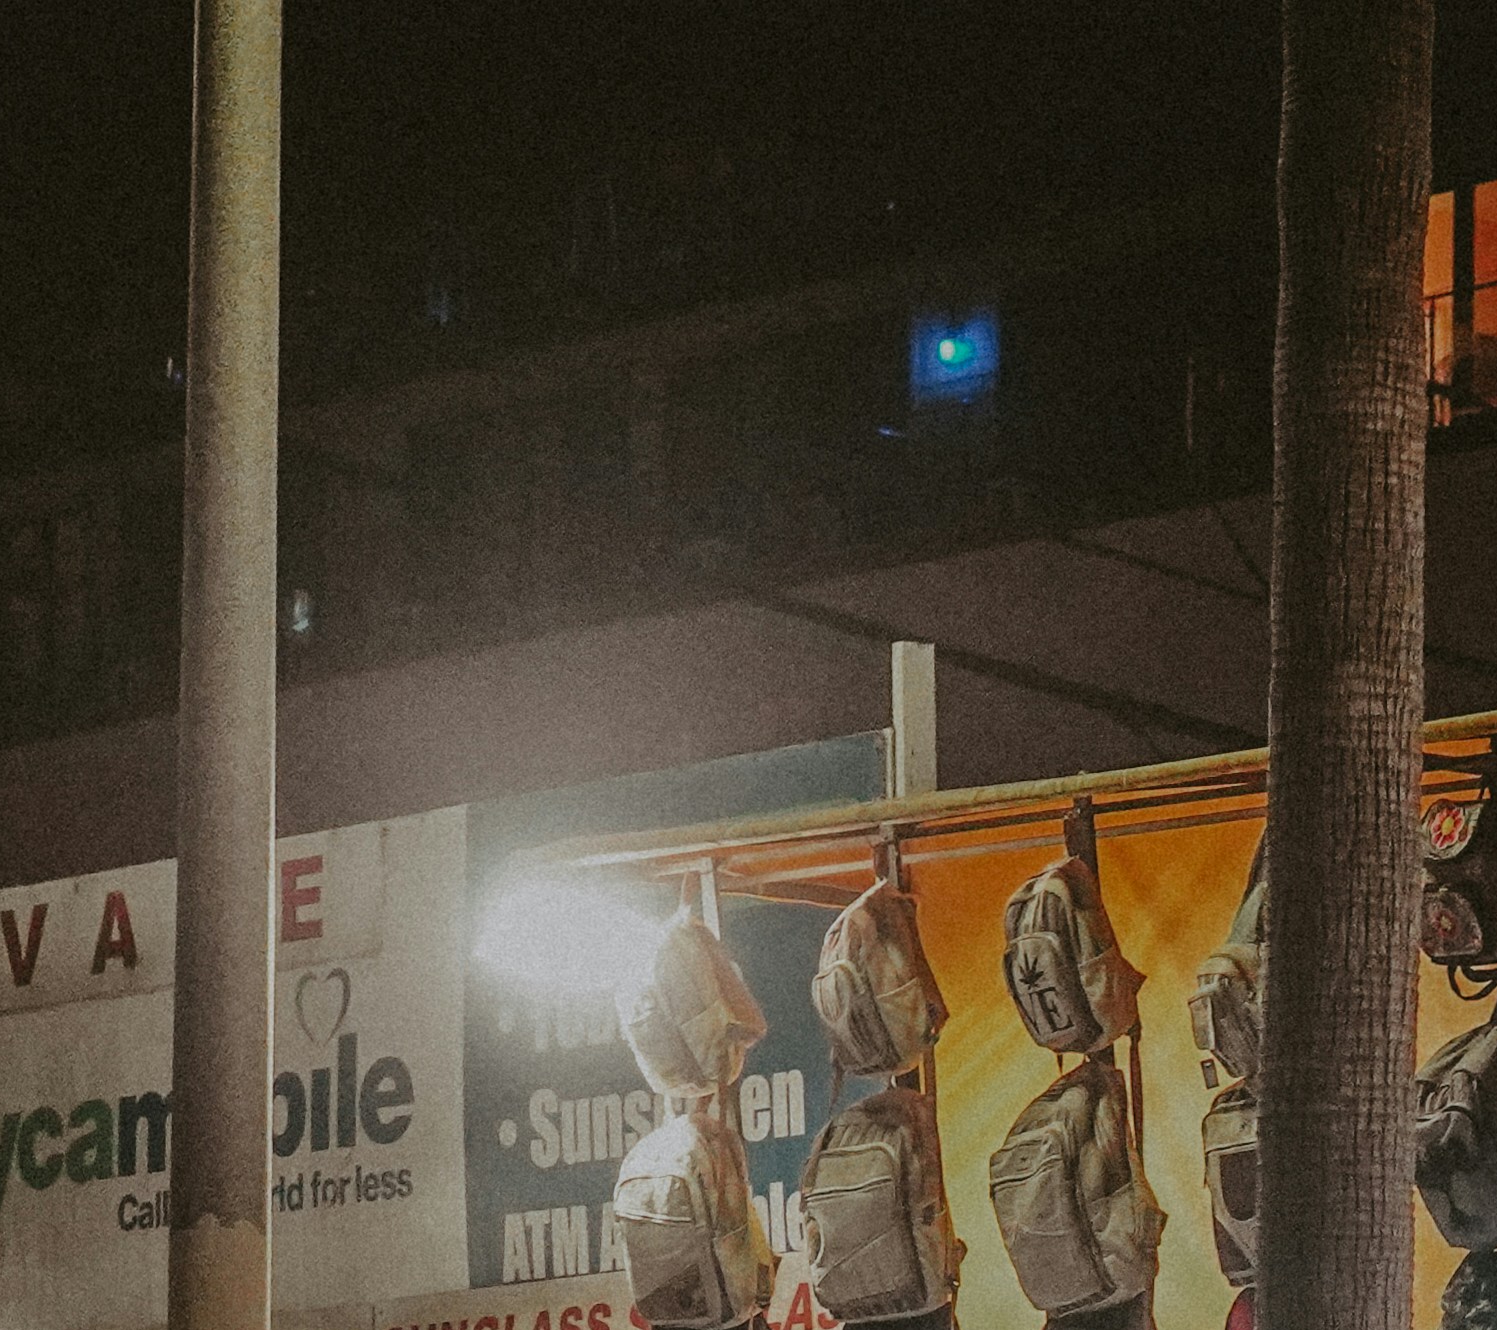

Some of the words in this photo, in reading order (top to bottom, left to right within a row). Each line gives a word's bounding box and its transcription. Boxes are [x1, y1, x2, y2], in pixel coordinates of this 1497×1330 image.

[0, 855, 323, 987] VAE
[311, 1170, 351, 1208] for
[354, 1165, 413, 1203] less
[503, 1205, 589, 1284] ATM
